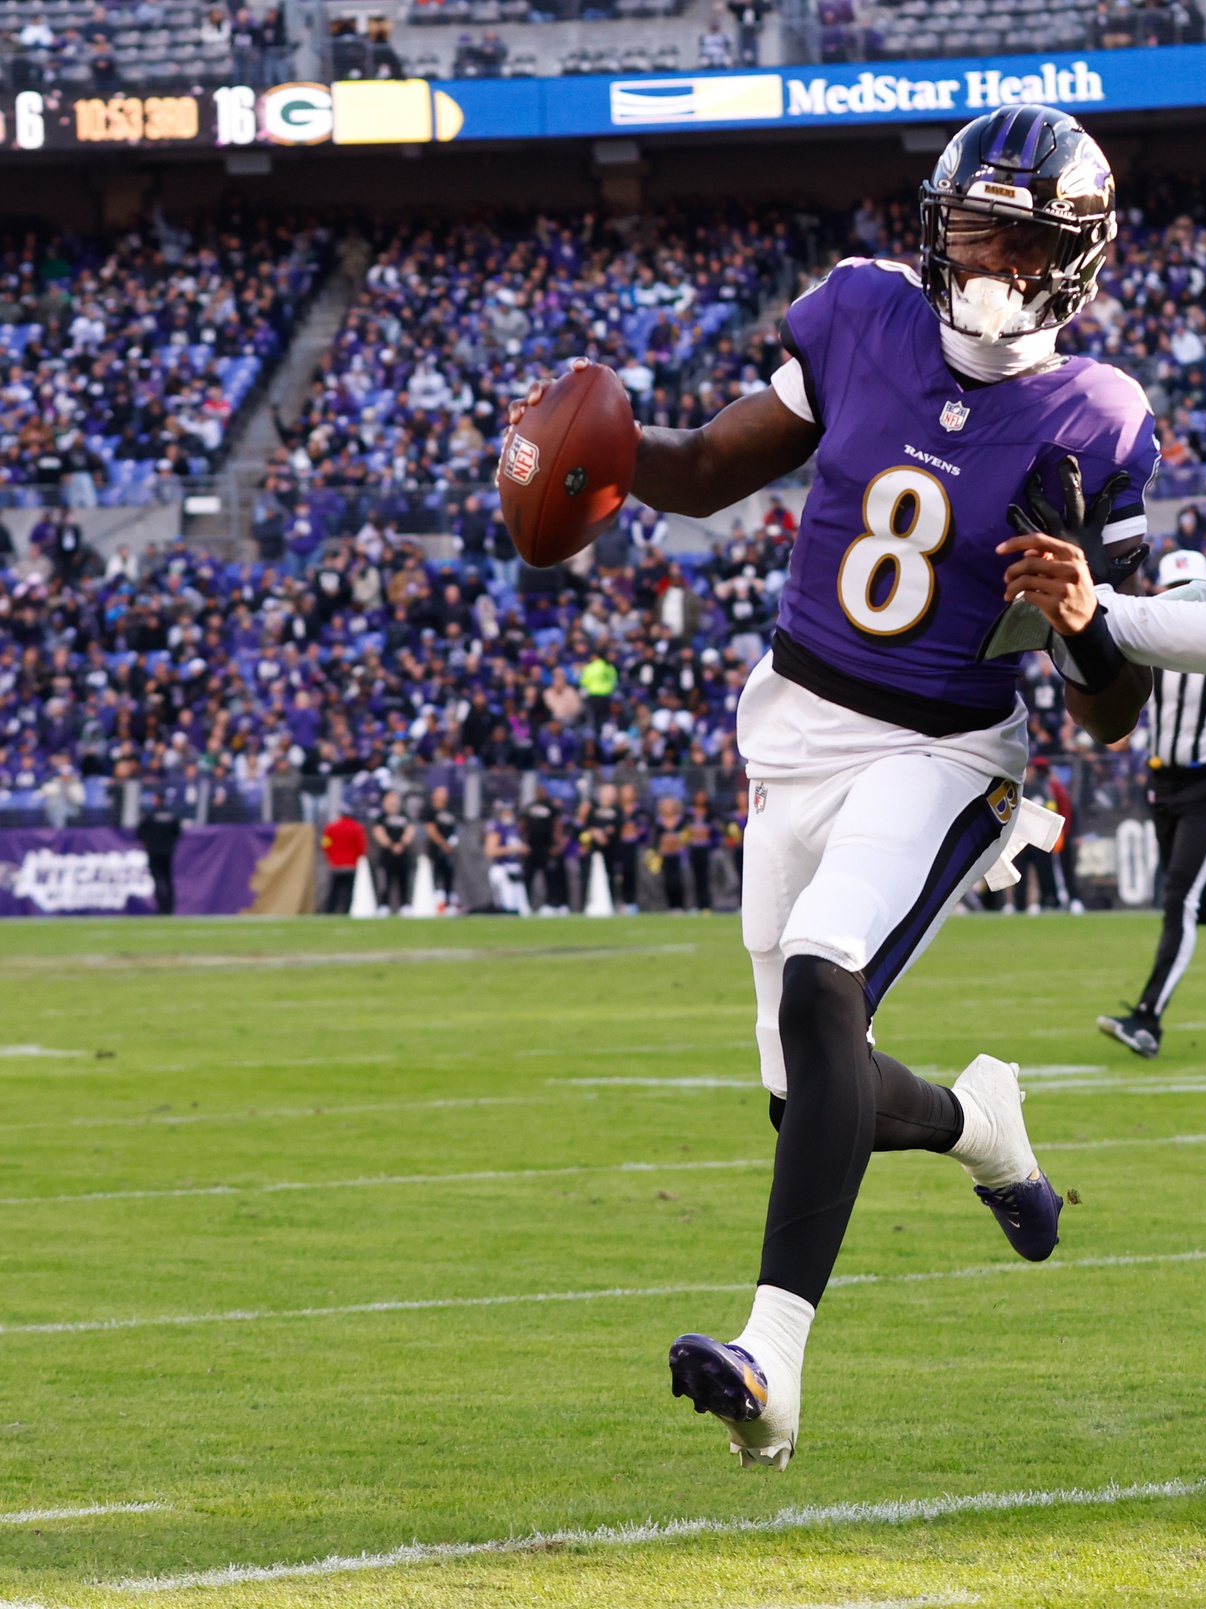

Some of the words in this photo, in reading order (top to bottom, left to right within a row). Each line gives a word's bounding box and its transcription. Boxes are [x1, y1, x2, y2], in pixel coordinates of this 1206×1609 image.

[787, 73, 959, 116] MedStar
[964, 61, 1105, 108] Health
[15, 91, 44, 149] 6
[213, 86, 256, 145] 16
[944, 412, 961, 428] NFL
[513, 447, 535, 480] NFL
[903, 444, 961, 476] RAVENS
[837, 465, 951, 636] 8
